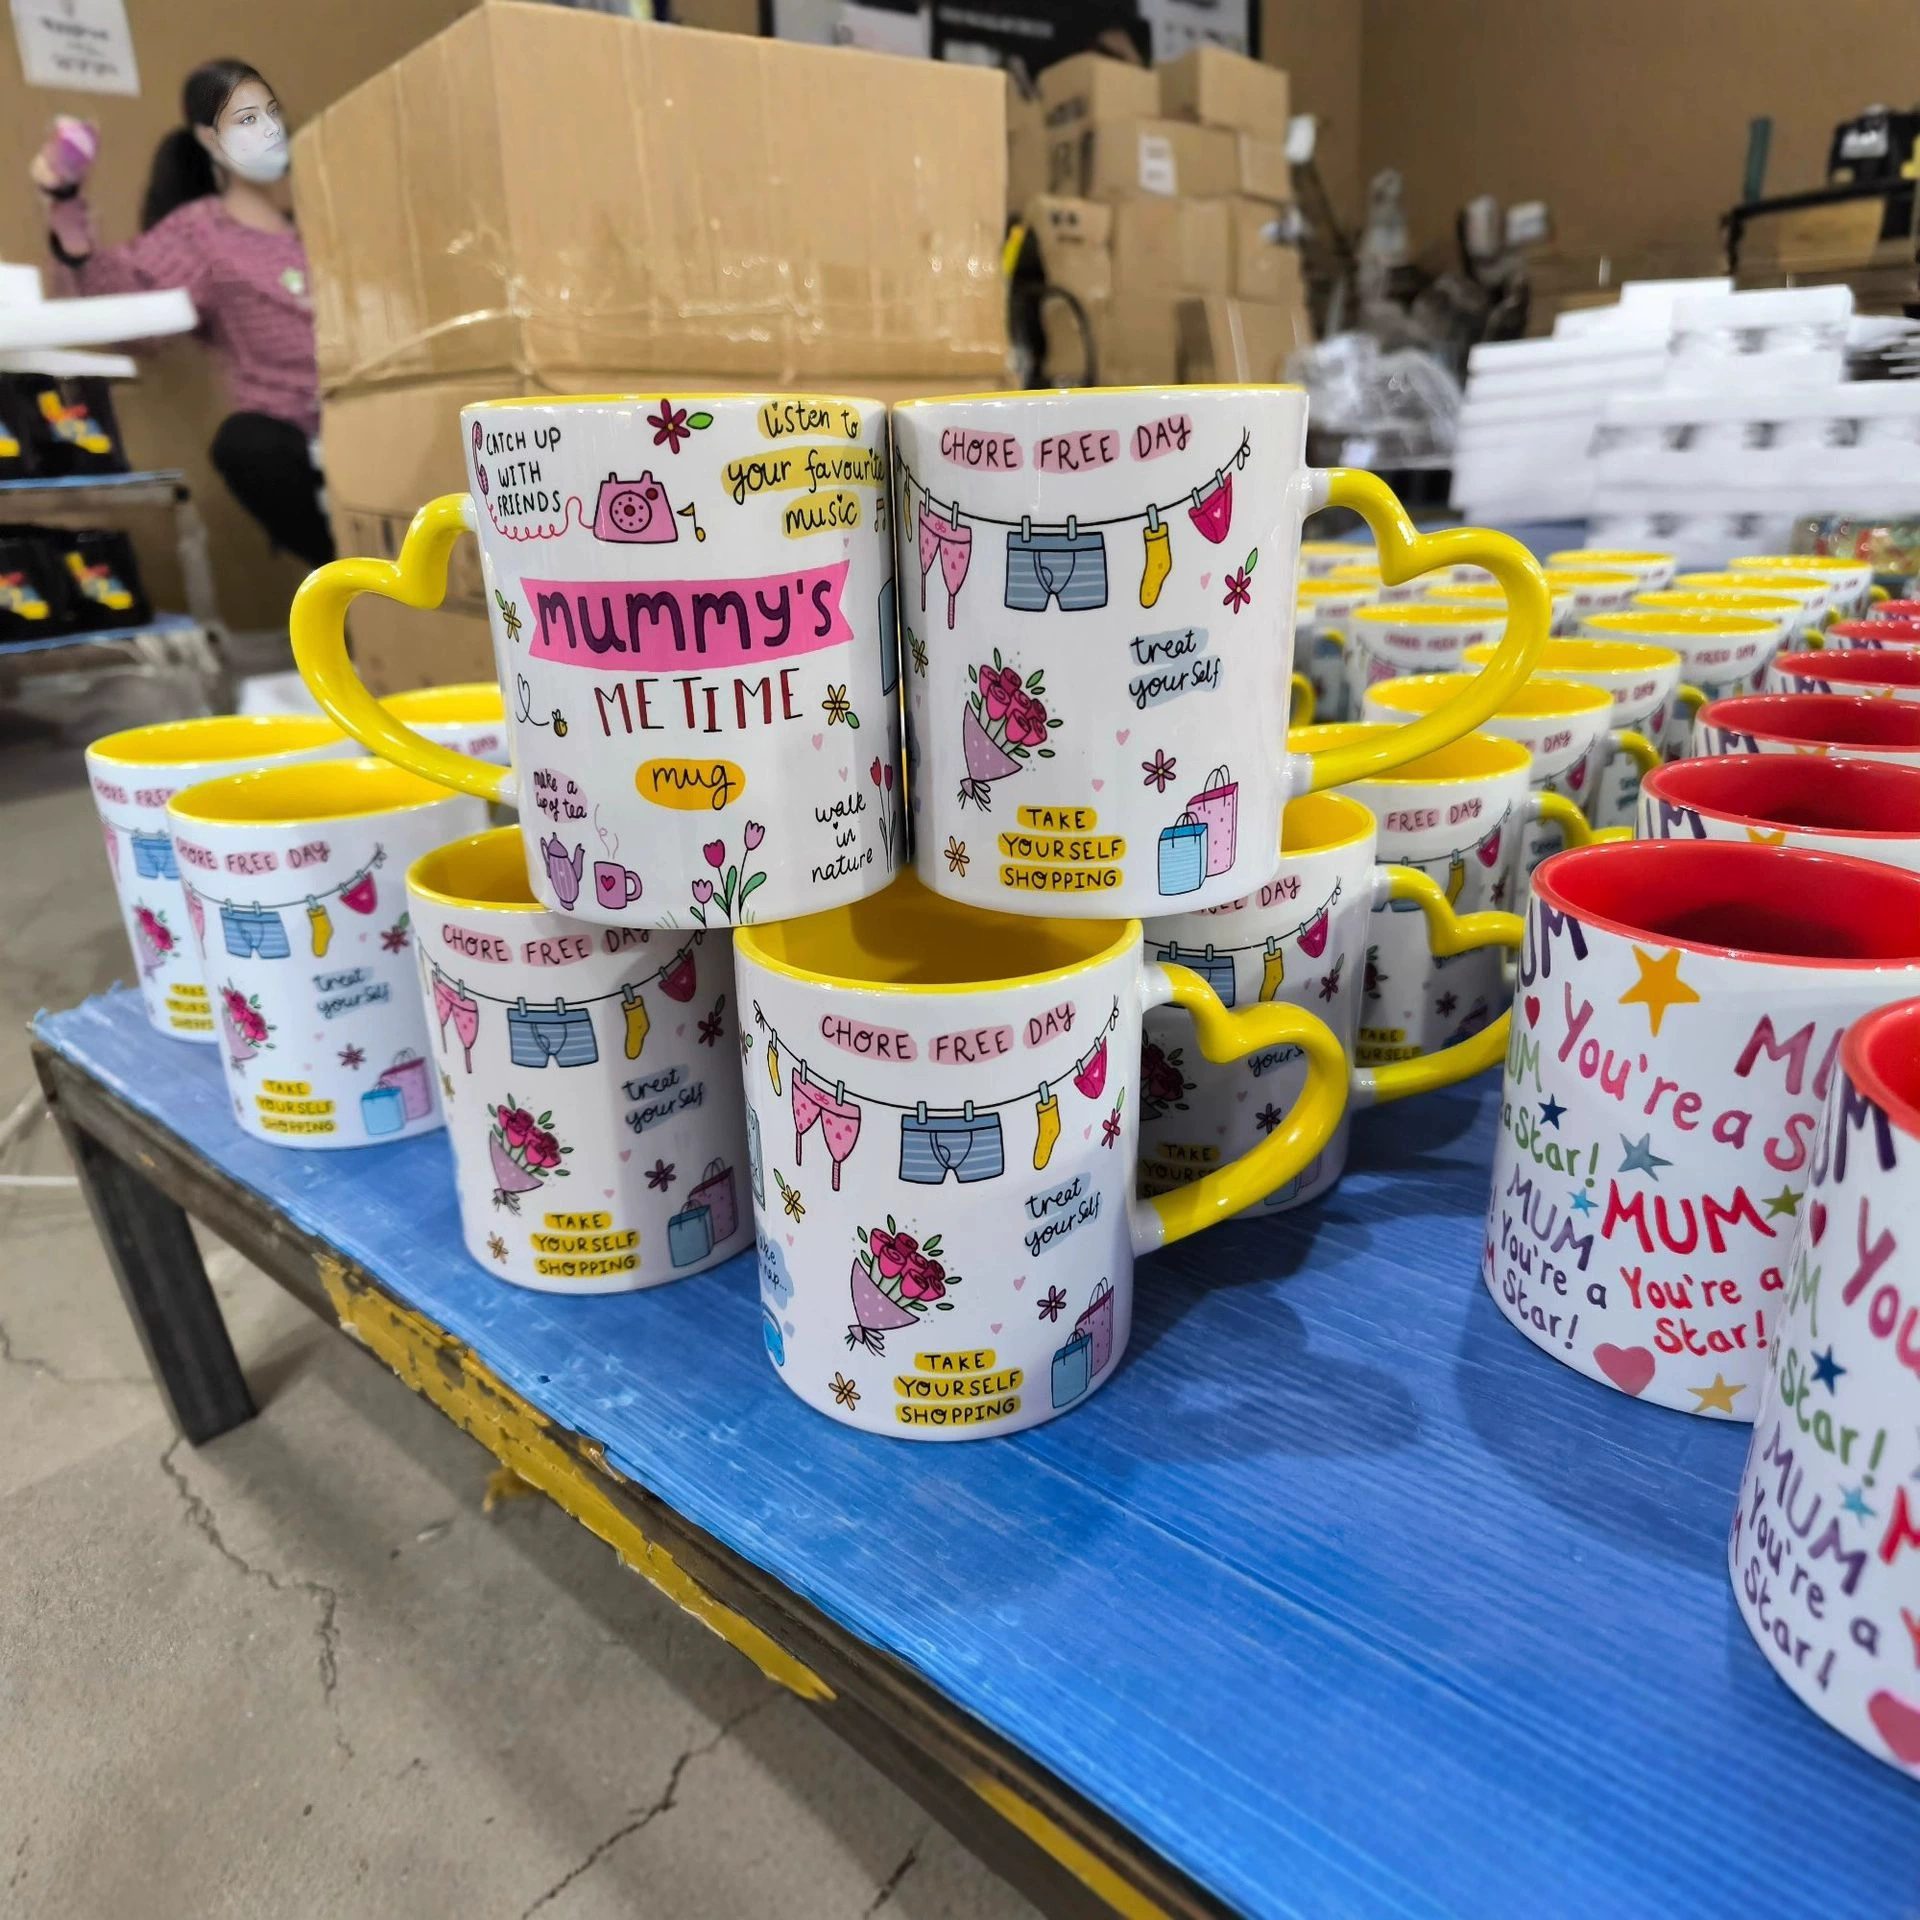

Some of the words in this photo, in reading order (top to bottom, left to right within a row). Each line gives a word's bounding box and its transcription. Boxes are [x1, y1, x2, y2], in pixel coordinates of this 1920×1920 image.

[764, 401, 830, 438] listen
[841, 410, 860, 440] to
[486, 427, 527, 456] CATCH
[535, 426, 562, 452] UP
[940, 429, 1018, 469] CHORE
[1039, 433, 1114, 471] FREE
[1136, 415, 1191, 459] DAY
[498, 461, 541, 489] WITH
[727, 457, 792, 505] your
[804, 447, 885, 494] favourite
[497, 490, 561, 517] FRIENDS
[785, 494, 858, 531] music
[1130, 629, 1197, 664] treat
[566, 780, 578, 795] a
[652, 765, 737, 811] mug
[562, 799, 587, 819] tea
[815, 792, 866, 826] walk
[1026, 808, 1087, 830] TAKE
[1387, 810, 1437, 832] FREE
[1449, 798, 1482, 824] DAY
[833, 821, 856, 849] in
[1001, 833, 1123, 861] YOURSELF
[228, 852, 276, 875] FREE
[289, 840, 330, 868] DAY
[811, 849, 874, 883] nature
[1004, 869, 1118, 890] SHOPPING
[1261, 876, 1301, 907] DAY
[442, 924, 508, 962] CHORE
[526, 938, 588, 965] FREE
[1517, 896, 1588, 992] UM
[821, 1015, 912, 1061] CHORE
[935, 1029, 1009, 1064] FREE
[1028, 1002, 1077, 1045] DAY
[1558, 981, 1702, 1131] You're
[1713, 1110, 1752, 1149] a
[621, 1068, 680, 1101] treat
[1515, 1105, 1599, 1187] Star!
[1025, 1178, 1082, 1218] treat
[551, 1214, 604, 1230] TAKE
[1507, 1163, 1594, 1271] MUM
[1601, 1178, 1777, 1254] MUM
[534, 1230, 637, 1253] YOURSELF
[538, 1256, 637, 1277] SHOPPING
[1502, 1210, 1567, 1296] You're
[1587, 1283, 1607, 1309] a
[1620, 1265, 1743, 1310] You're
[1760, 1267, 1784, 1292] a
[1503, 1267, 1579, 1349] Star!
[1654, 1309, 1768, 1357] Star!
[924, 1352, 986, 1371] TAKE
[899, 1370, 1021, 1398] YOURSELF
[901, 1398, 1017, 1425] SHOPPING
[1780, 1347, 1886, 1488] Star!
[1763, 1420, 1868, 1597] MUM
[1749, 1476, 1824, 1620] You're
[1850, 1615, 1881, 1657] a
